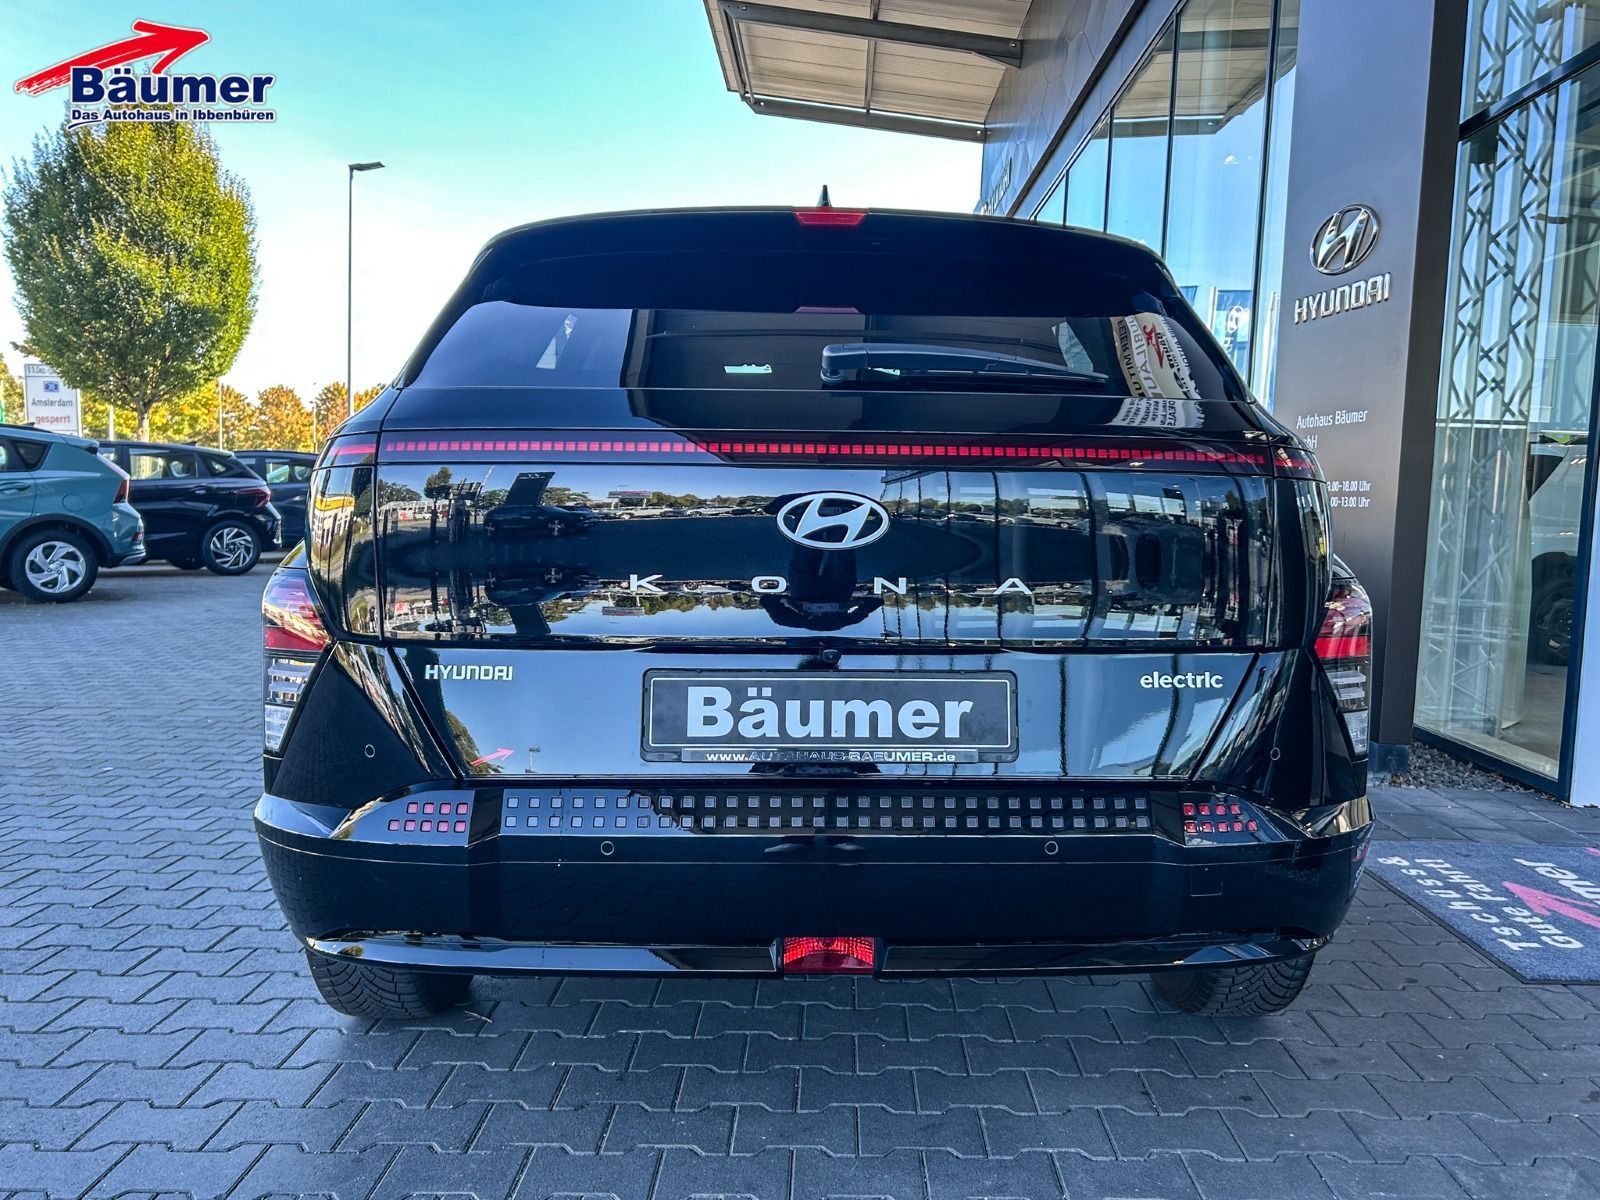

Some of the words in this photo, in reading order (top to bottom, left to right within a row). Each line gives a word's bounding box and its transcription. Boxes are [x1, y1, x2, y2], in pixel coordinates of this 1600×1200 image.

[1294, 272, 1391, 324] HYUNDAI
[31, 399, 73, 407] Amsterdam
[35, 415, 71, 425] gesperrt
[1296, 413, 1333, 429] Autohaus
[1335, 409, 1368, 425] Bäumer
[1359, 480, 1371, 491] Uhr
[1330, 496, 1357, 508] 00-13.00
[1358, 496, 1371, 508] Uhr
[425, 664, 513, 681] HYUNDAI
[1140, 671, 1224, 688] electric
[687, 685, 974, 739] Bäumer
[1400, 868, 1543, 951] Tschüss
[1501, 906, 1584, 949] Gute
